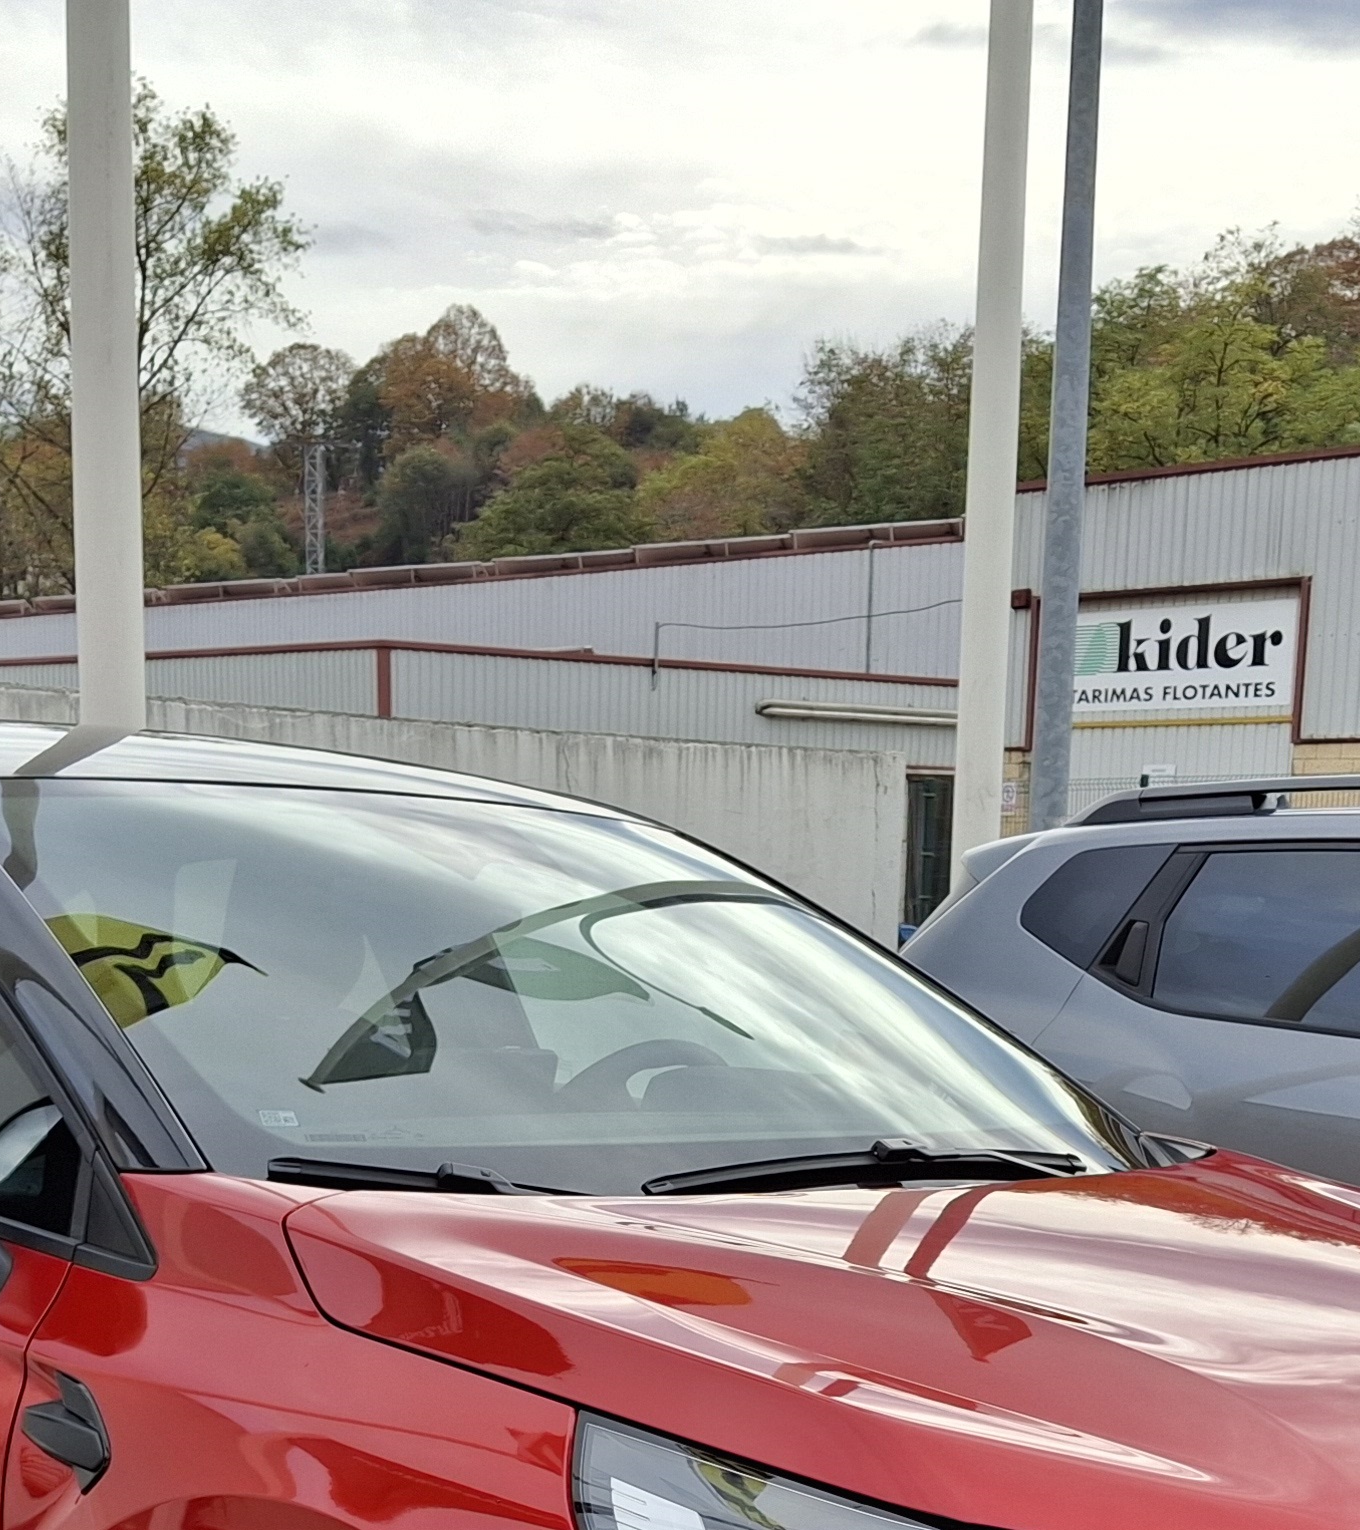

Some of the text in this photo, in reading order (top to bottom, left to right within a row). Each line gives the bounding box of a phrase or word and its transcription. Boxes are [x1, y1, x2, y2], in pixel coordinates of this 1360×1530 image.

[1115, 614, 1283, 673] kider
[1073, 681, 1276, 704] ARIMAS FLOTANTES
